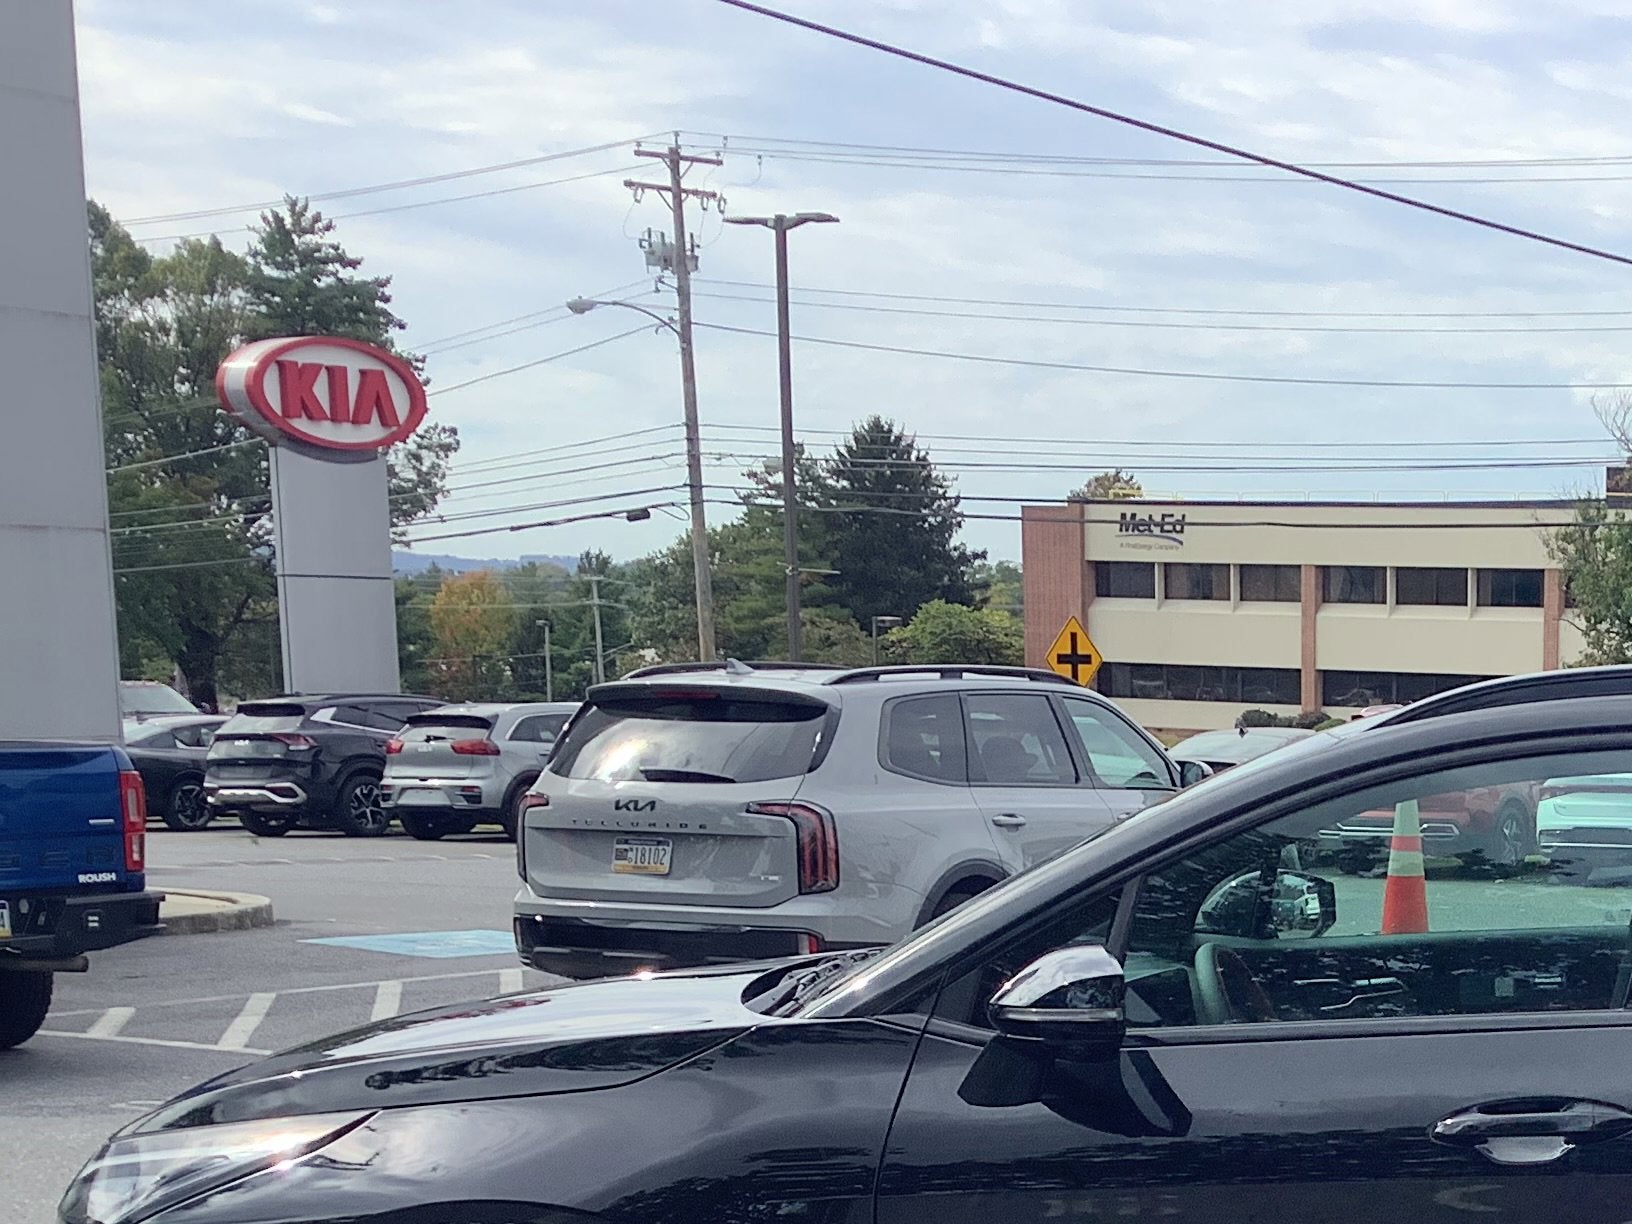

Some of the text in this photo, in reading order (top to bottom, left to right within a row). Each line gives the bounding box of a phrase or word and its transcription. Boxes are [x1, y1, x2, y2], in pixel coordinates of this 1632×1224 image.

[276, 359, 401, 428] KIA
[614, 799, 656, 812] KIA
[633, 847, 667, 866] 18102
[77, 872, 117, 884] ROUSH
